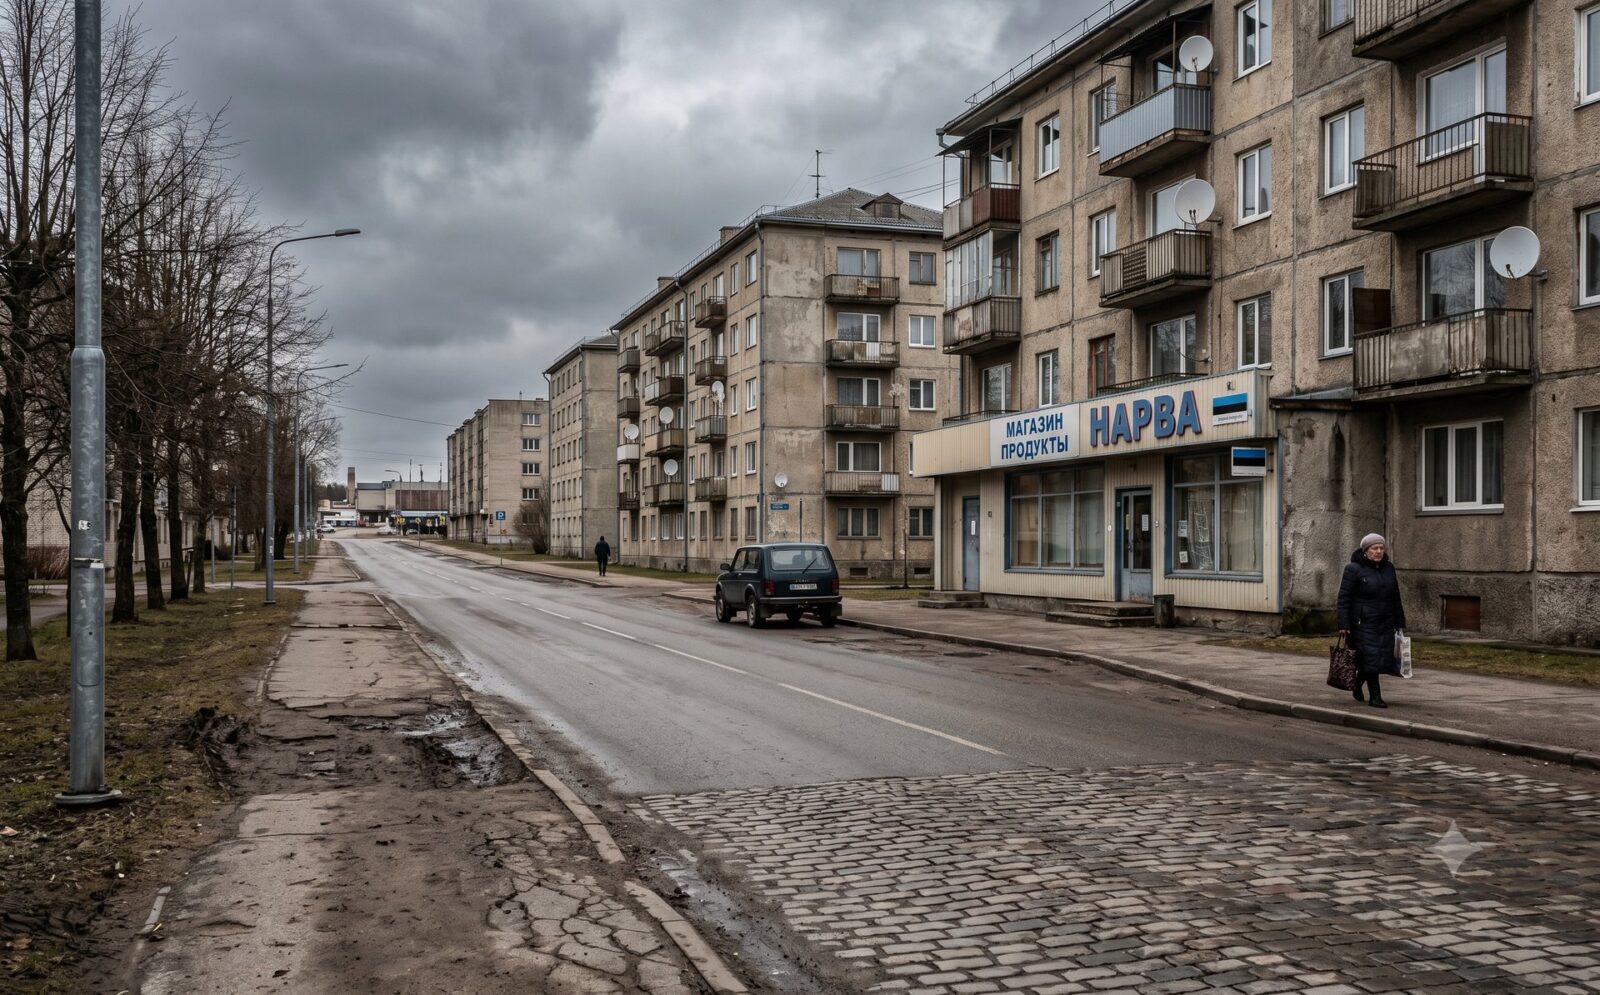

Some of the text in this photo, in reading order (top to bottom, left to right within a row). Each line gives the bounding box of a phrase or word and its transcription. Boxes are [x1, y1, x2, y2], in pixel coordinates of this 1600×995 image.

[1006, 413, 1063, 437] МАГАЗИН
[1090, 390, 1201, 447] НАРВА
[1001, 436, 1068, 460] ПРОДУКТЫ
